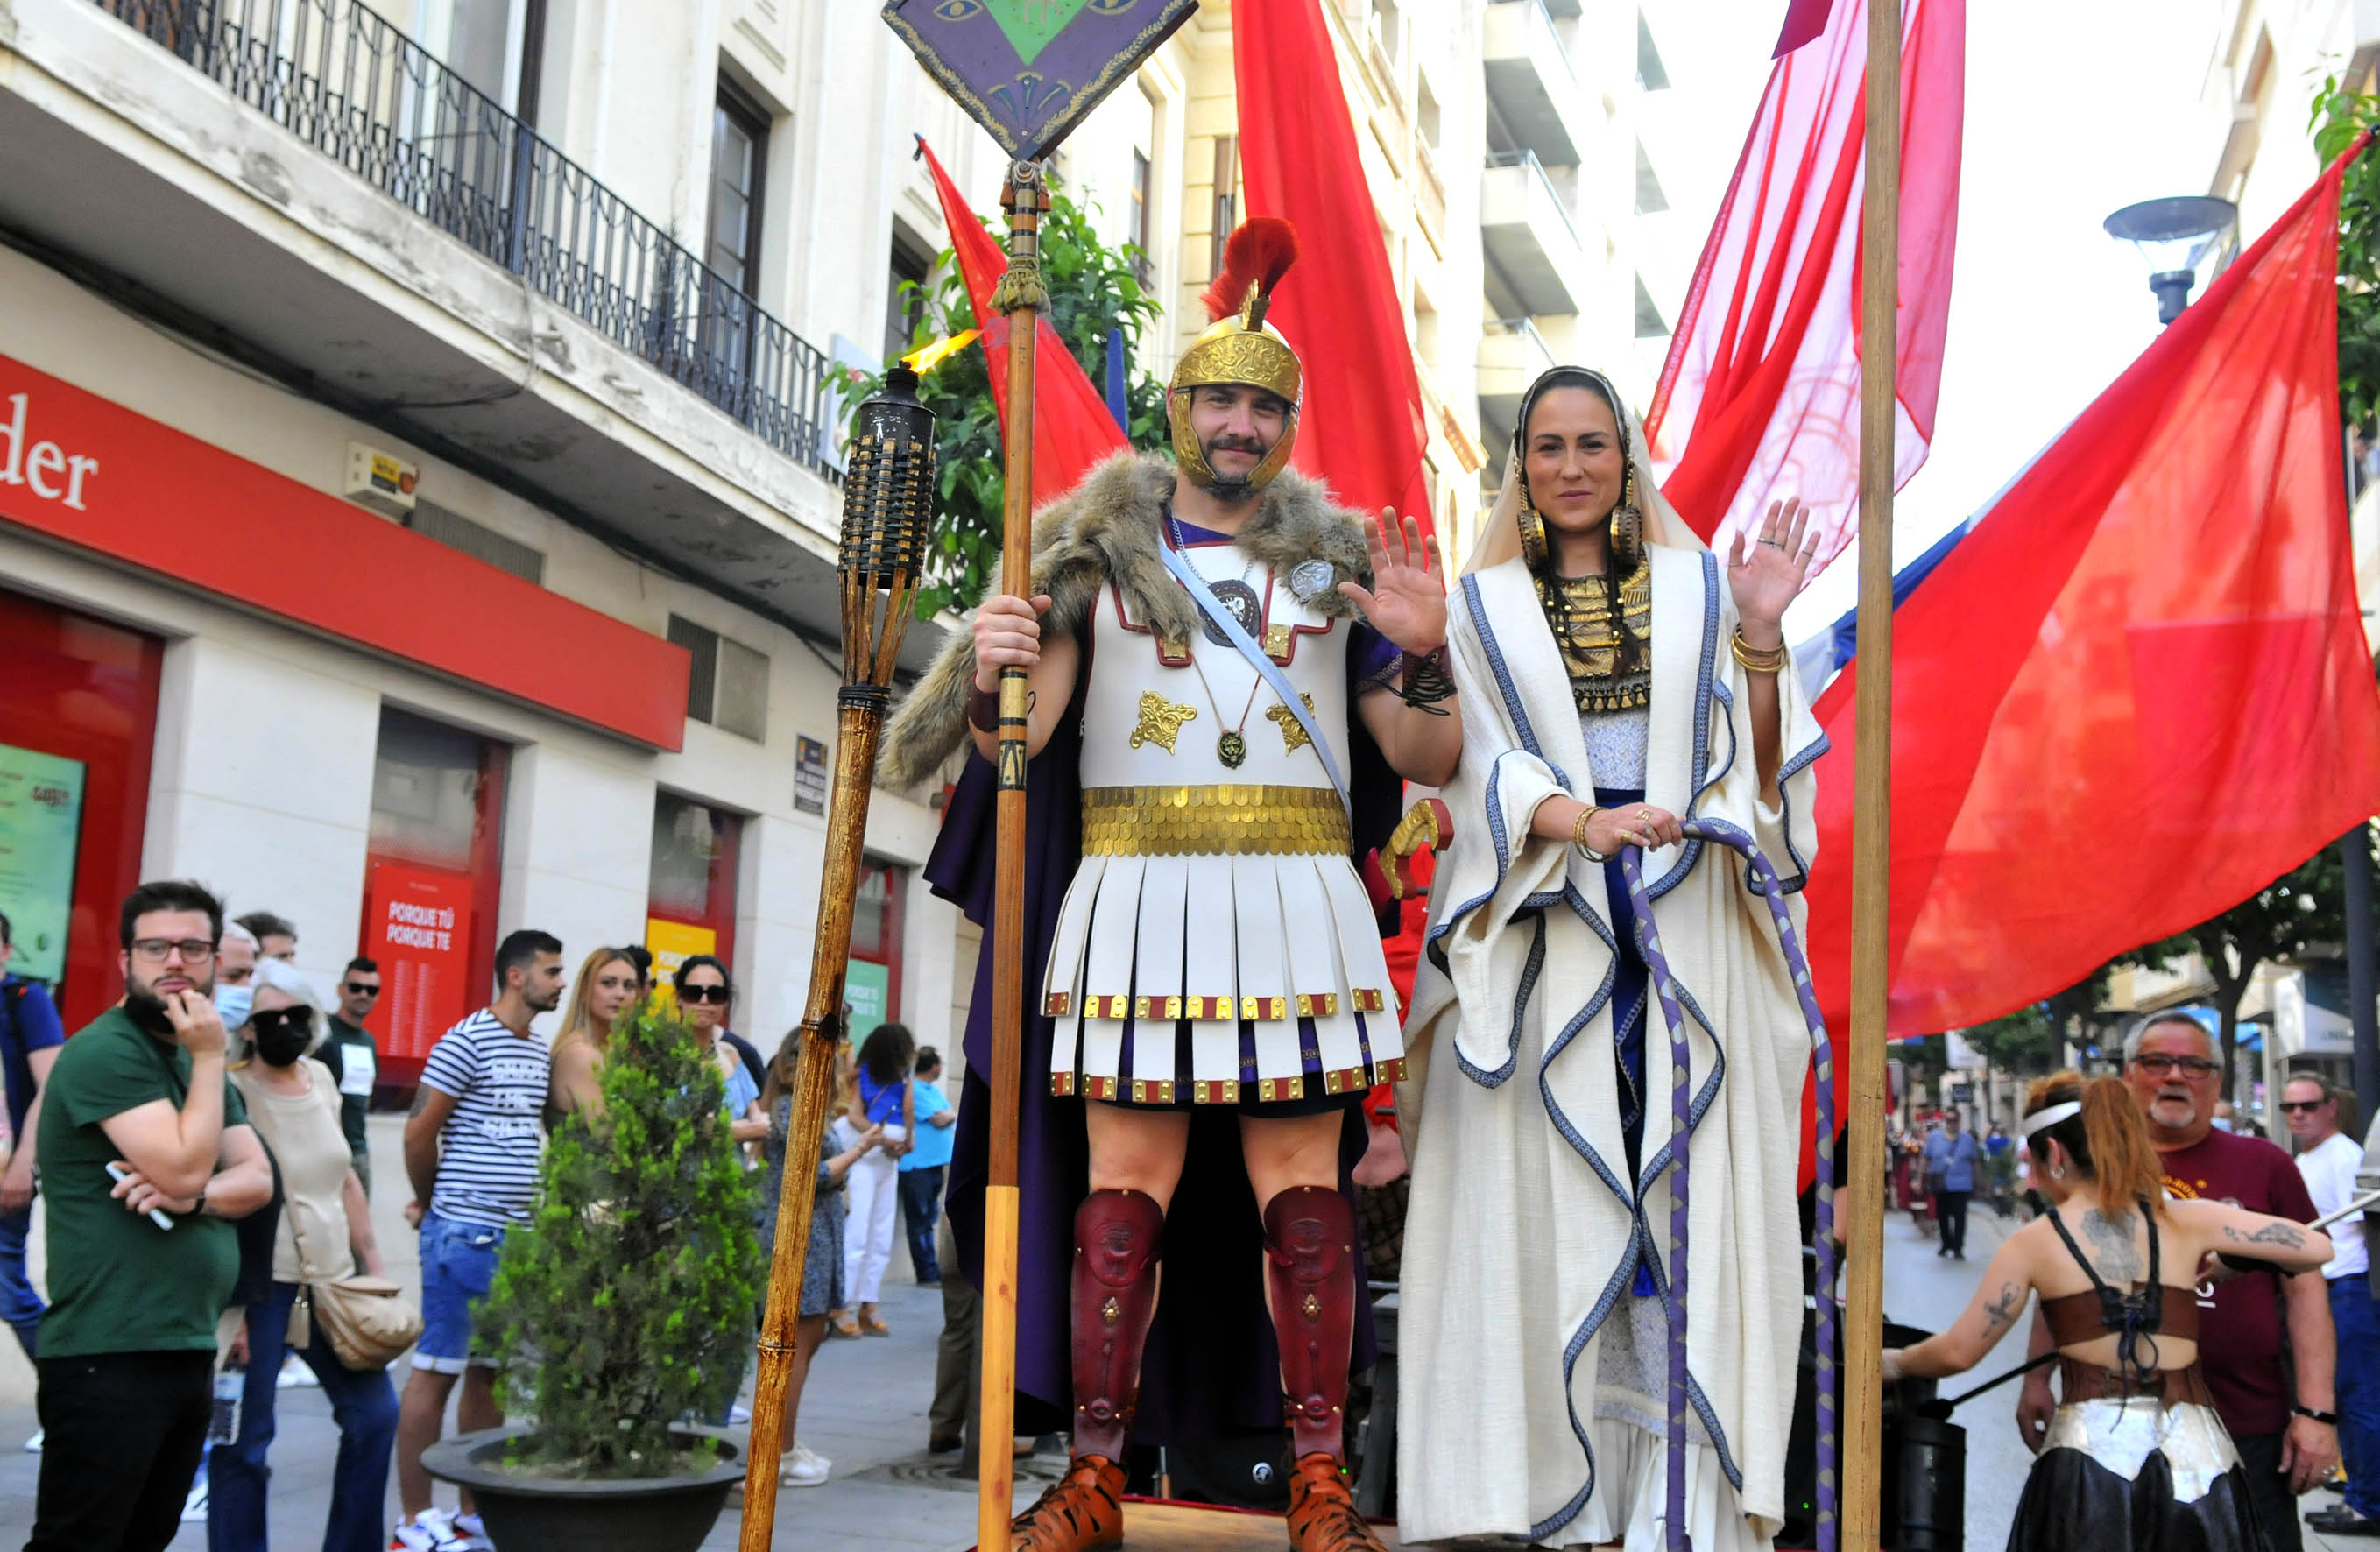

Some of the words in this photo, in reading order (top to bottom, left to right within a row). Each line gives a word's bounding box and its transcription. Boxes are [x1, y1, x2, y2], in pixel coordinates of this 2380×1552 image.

[388, 901, 436, 927] PORQUE
[438, 907, 455, 929] TÚ
[386, 924, 435, 949] PORQUE
[437, 931, 452, 951] TE
